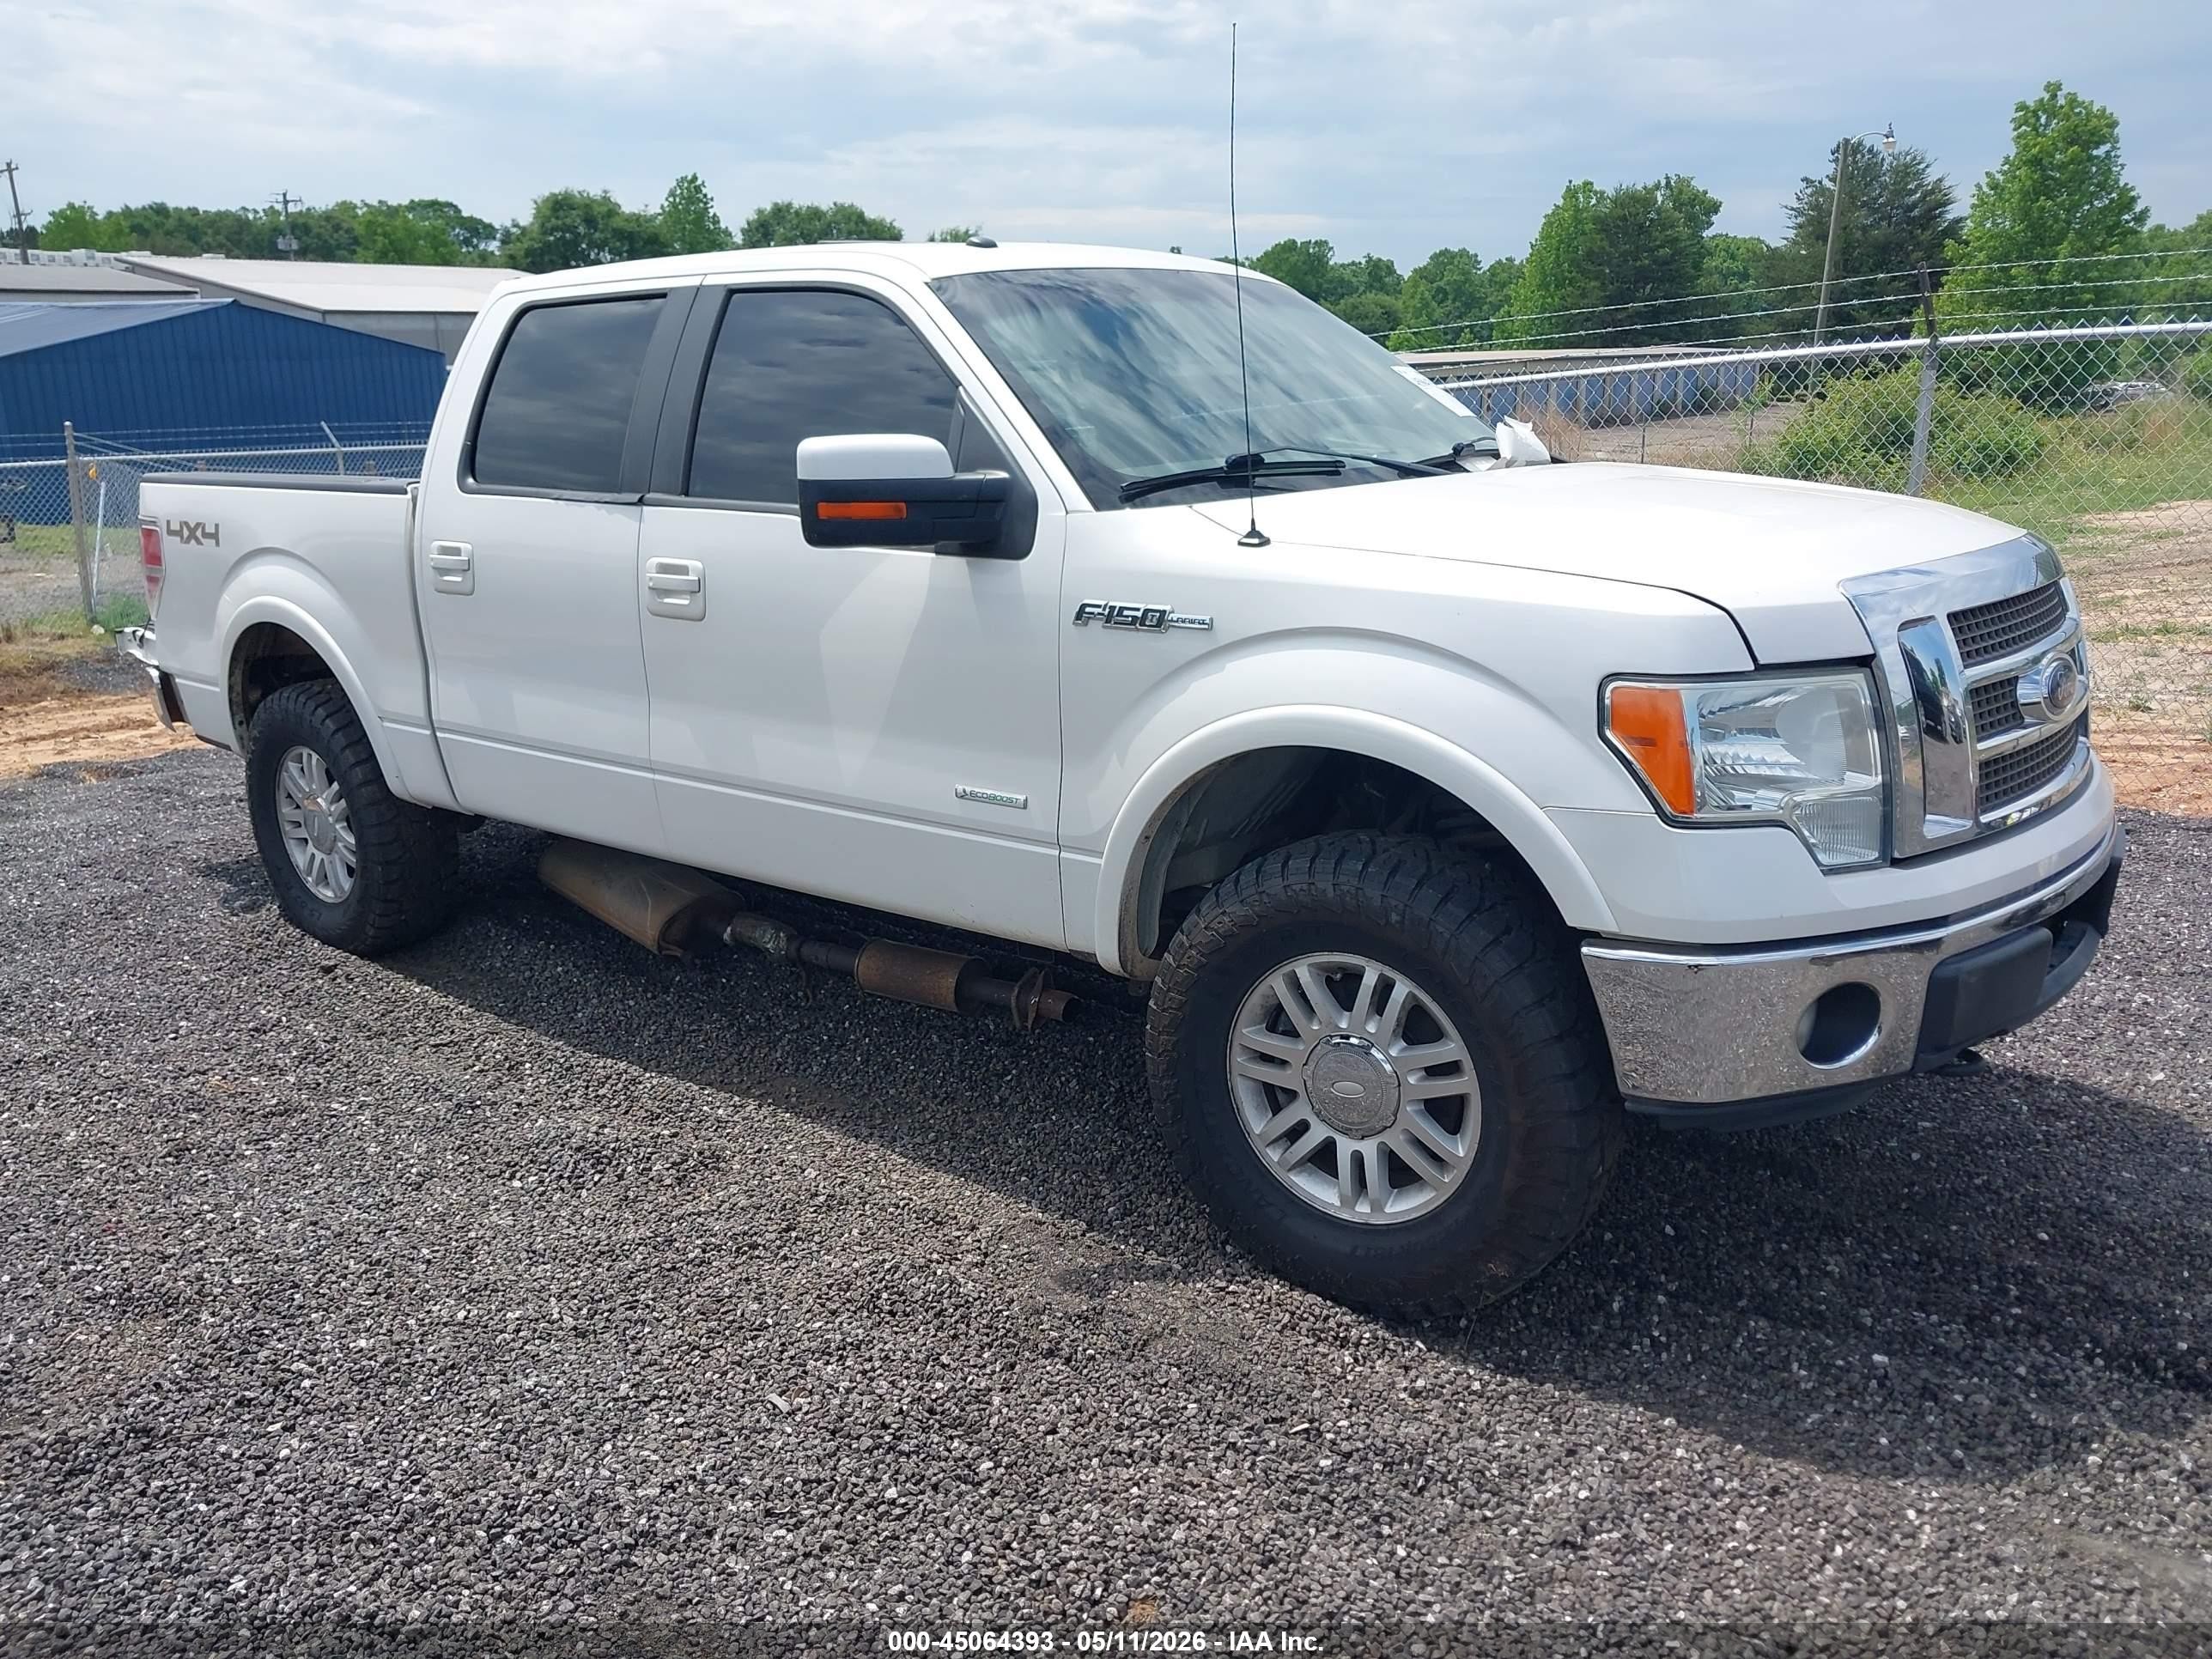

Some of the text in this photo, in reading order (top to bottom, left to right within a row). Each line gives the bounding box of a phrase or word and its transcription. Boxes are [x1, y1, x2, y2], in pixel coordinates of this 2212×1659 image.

[166, 520, 220, 547] 4X4
[1074, 601, 1169, 630] F-150
[969, 789, 1021, 805] ECOBOOST
